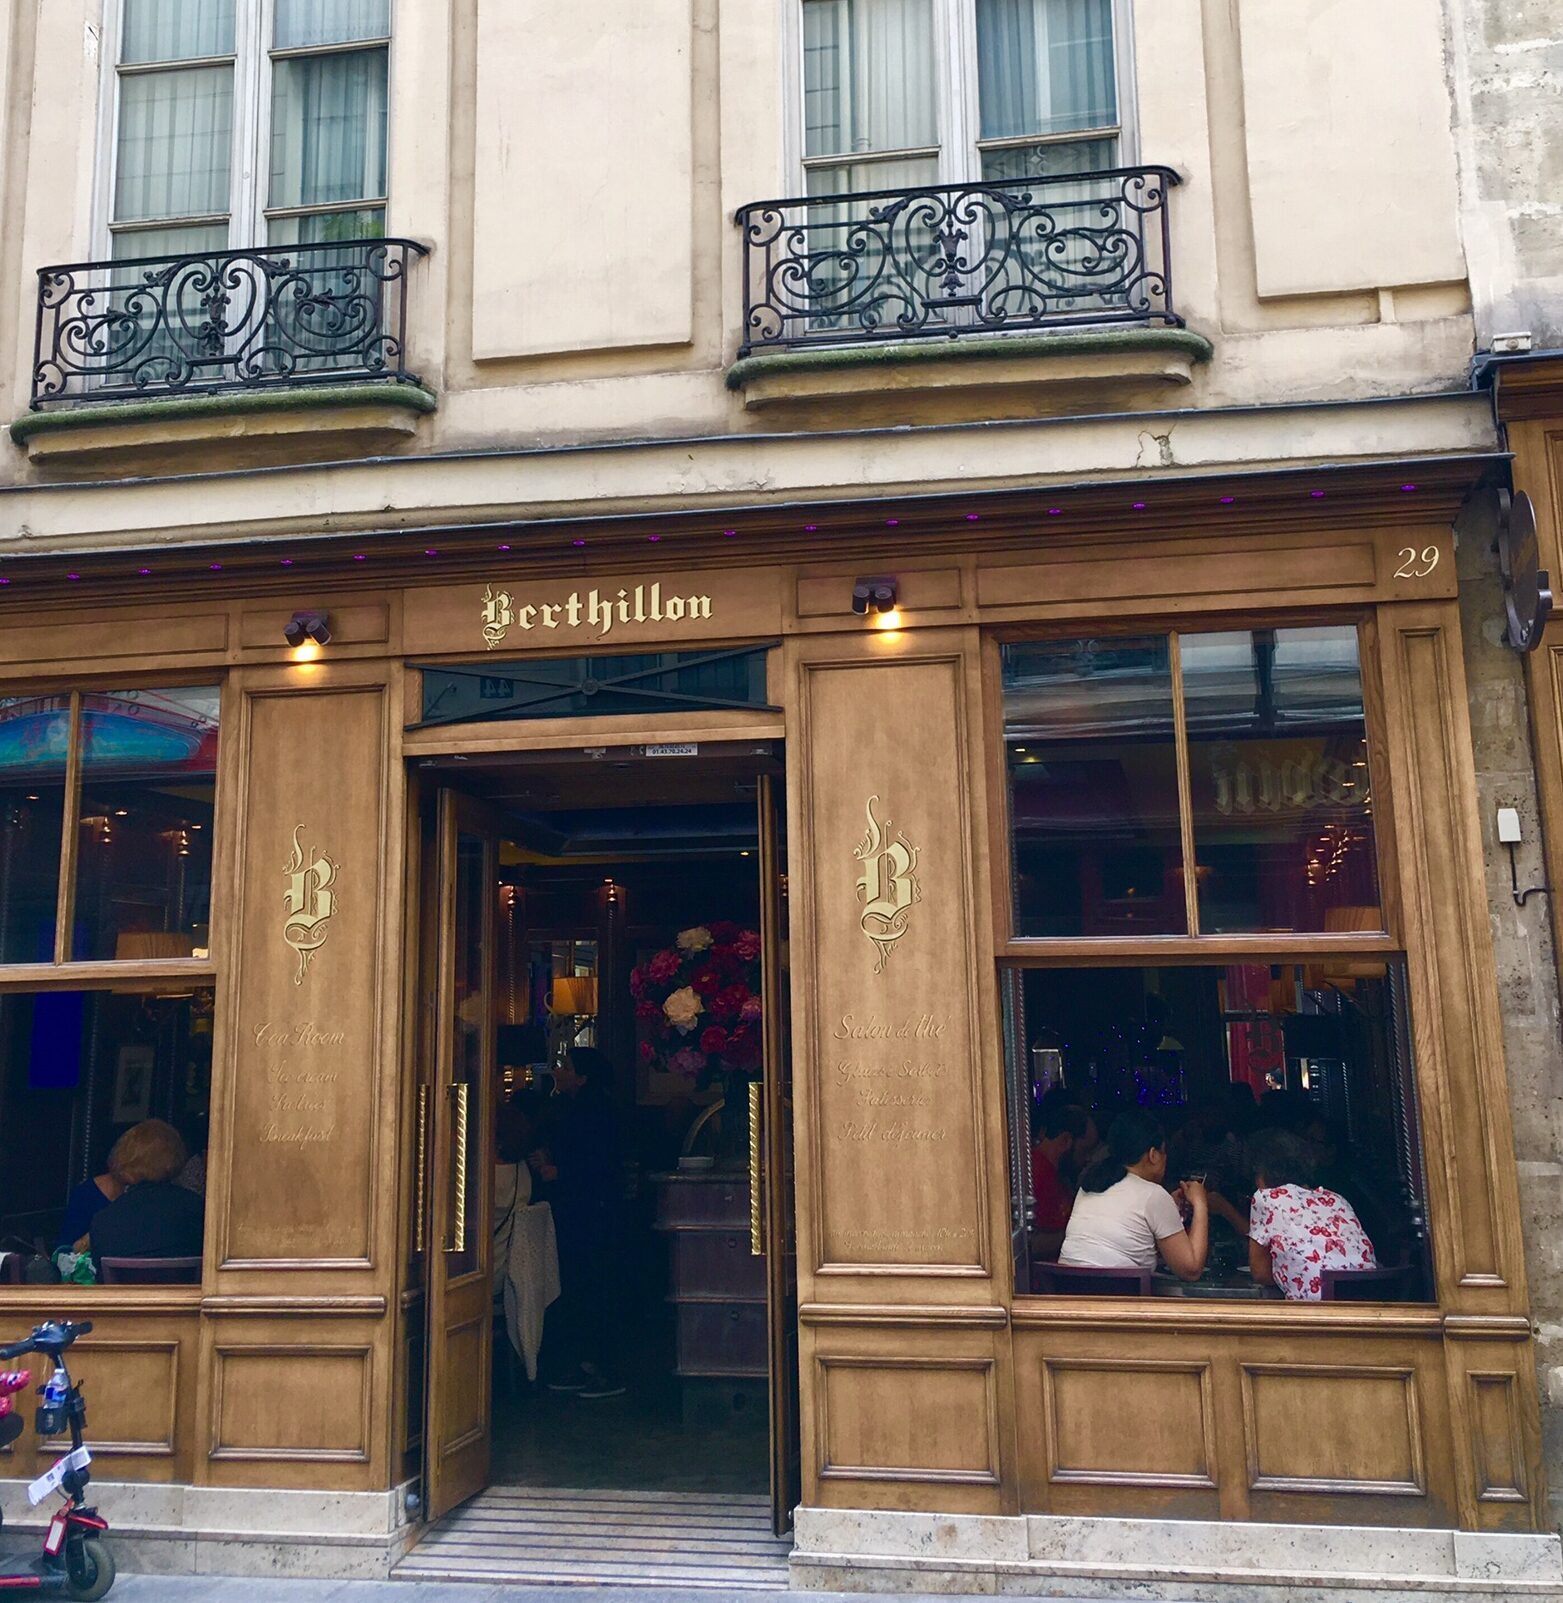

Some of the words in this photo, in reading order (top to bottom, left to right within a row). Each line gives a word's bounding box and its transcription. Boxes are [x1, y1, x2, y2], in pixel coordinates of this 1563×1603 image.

[1393, 545, 1439, 578] 29
[481, 582, 713, 650] Berthillon
[282, 824, 341, 985] B
[853, 795, 921, 975] B
[253, 1021, 289, 1047] Tea
[291, 1021, 345, 1047] Room
[833, 1014, 892, 1040] Salon
